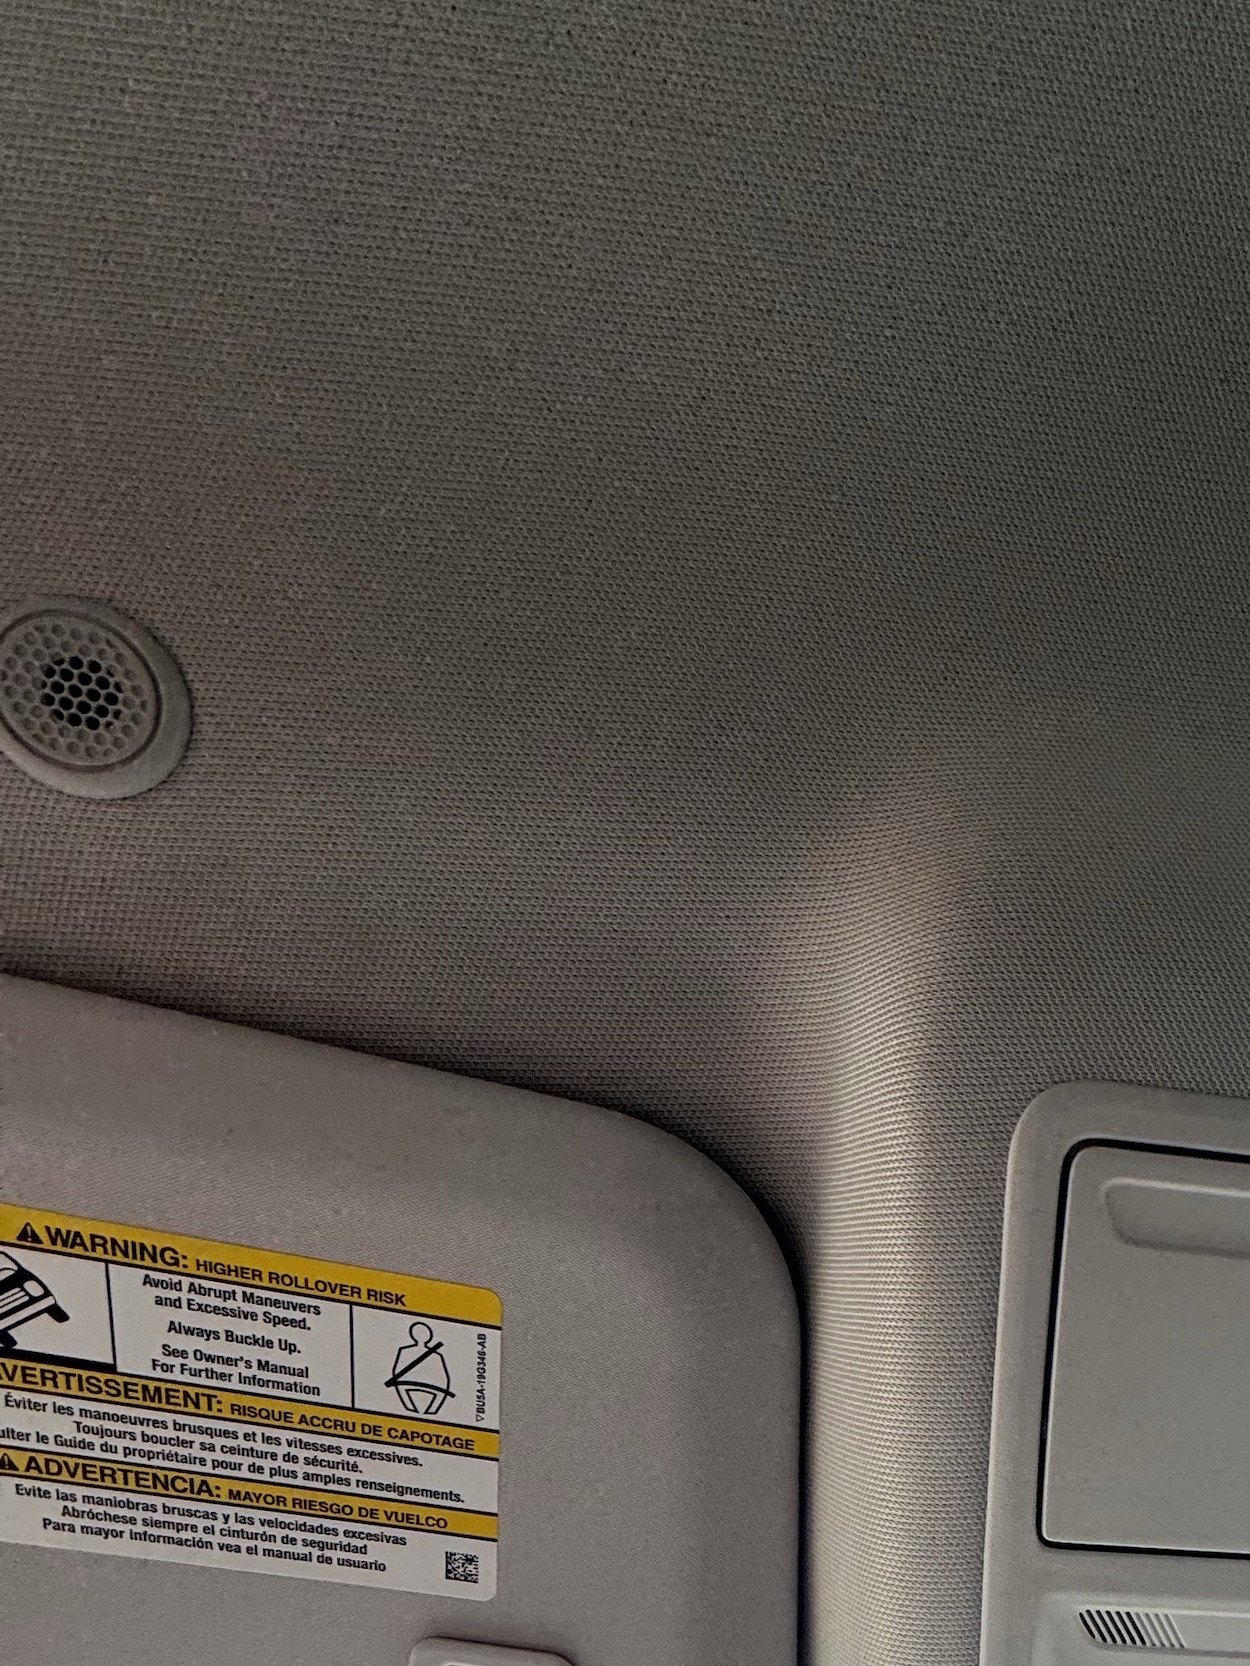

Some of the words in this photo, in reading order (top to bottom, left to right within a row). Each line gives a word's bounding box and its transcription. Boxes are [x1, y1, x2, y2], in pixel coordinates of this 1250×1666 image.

[45, 1225, 188, 1268] WARNING:
[196, 1259, 263, 1282] HIGHER
[268, 1271, 362, 1298] ROLLOVER
[366, 1288, 407, 1307] RISK
[143, 1274, 182, 1292] Avoid
[188, 1281, 238, 1302] Abrupt
[242, 1290, 322, 1316] Maneuvers
[154, 1295, 182, 1309] and
[187, 1298, 259, 1321] Excessive
[263, 1311, 311, 1331] Speed.
[161, 1343, 189, 1360] See
[193, 1349, 253, 1369] Owner's
[257, 1358, 309, 1379] Manual
[167, 1320, 220, 1342] Always
[225, 1330, 274, 1349] Buckle
[278, 1338, 302, 1355] Up.
[151, 1358, 176, 1374] For
[180, 1362, 234, 1383] Further
[238, 1371, 321, 1397] Information
[4, 1392, 48, 1413] Éviter
[53, 1401, 75, 1416] les
[79, 1407, 169, 1430] manoeuvres
[173, 1419, 239, 1440] brusques
[243, 1431, 257, 1443] et
[261, 1432, 282, 1446] les
[286, 1437, 343, 1455] vitesses
[346, 1447, 423, 1467] excessives.
[73, 1420, 137, 1441] Toujours
[141, 1430, 195, 1449] boucler
[199, 1441, 216, 1453] sa
[220, 1444, 278, 1461] ceinture
[282, 1451, 299, 1464] de
[303, 1455, 363, 1473] sécurité.
[230, 1403, 294, 1424] RISQUE
[298, 1414, 356, 1433] ACCRU
[361, 1423, 383, 1437] DE
[387, 1427, 475, 1451] CAPOTAGE
[24, 1455, 221, 1499] ADVERTENCIA:
[228, 1488, 287, 1508] MAYOR
[292, 1497, 354, 1516] RIESGO
[357, 1506, 380, 1520] DE
[383, 1510, 448, 1529] VUELCO
[36, 1431, 50, 1445] le
[54, 1434, 95, 1451] Guide
[100, 1441, 118, 1454] du
[123, 1446, 207, 1467] propriétaire
[212, 1459, 244, 1472] pour
[247, 1462, 265, 1475] de
[269, 1465, 298, 1479] plus
[302, 1471, 351, 1487] amples
[355, 1478, 465, 1503] renseignements.
[15, 1483, 51, 1500] Evite
[56, 1488, 77, 1503] las
[82, 1494, 158, 1514] maniobras
[162, 1502, 218, 1521] bruscas
[222, 1513, 230, 1525] y
[234, 1512, 255, 1526] las
[259, 1517, 339, 1537] velocidades
[343, 1528, 407, 1546] excesivas
[61, 1505, 137, 1526] Abróchese
[141, 1516, 198, 1533] siempre
[203, 1524, 215, 1535] el
[219, 1527, 277, 1543] cinturón
[281, 1534, 298, 1546] de
[302, 1537, 368, 1555] seguridad
[42, 1517, 76, 1533] Para
[80, 1523, 125, 1540] mayor
[129, 1529, 213, 1550] información
[217, 1541, 242, 1554] vea
[245, 1544, 258, 1556] el
[262, 1547, 313, 1562] manual
[317, 1554, 333, 1565] de
[337, 1557, 386, 1572] usuario
